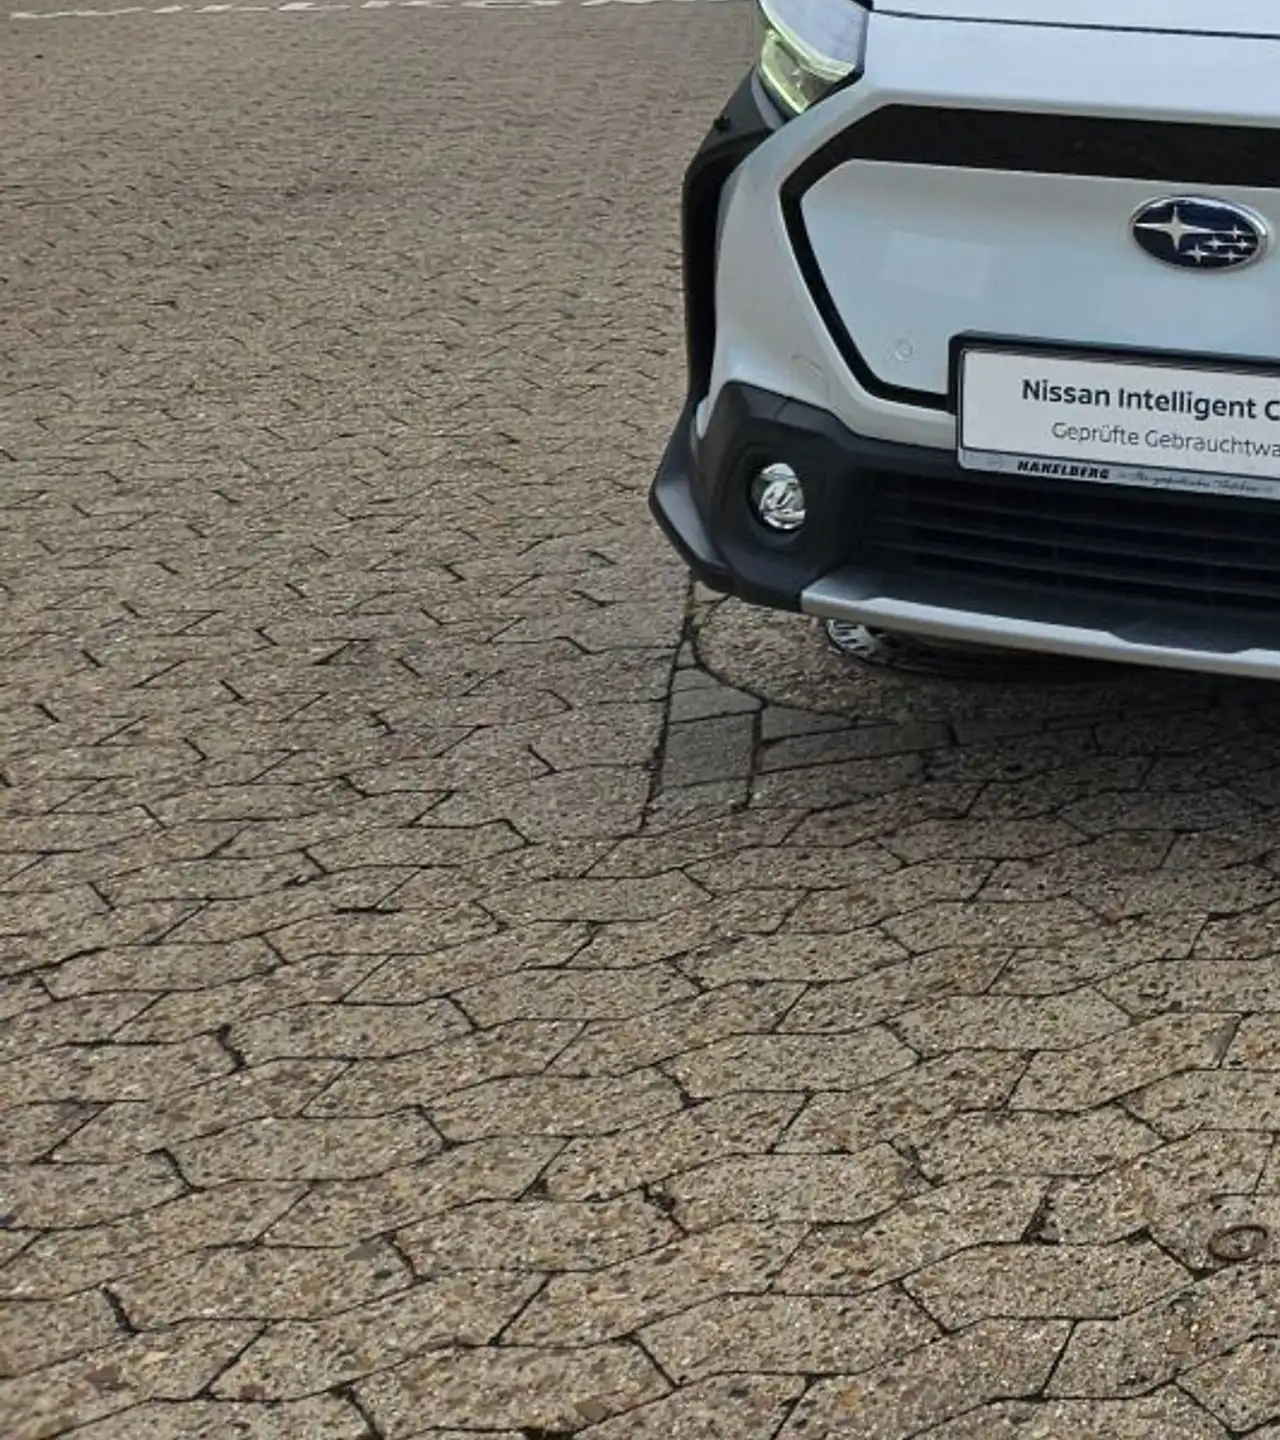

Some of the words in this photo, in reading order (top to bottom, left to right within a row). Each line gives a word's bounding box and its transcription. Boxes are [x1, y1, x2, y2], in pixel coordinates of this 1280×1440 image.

[1022, 379, 1111, 408] Nissan
[1118, 387, 1258, 422] Intelligent
[1052, 422, 1139, 446] Geprüfte
